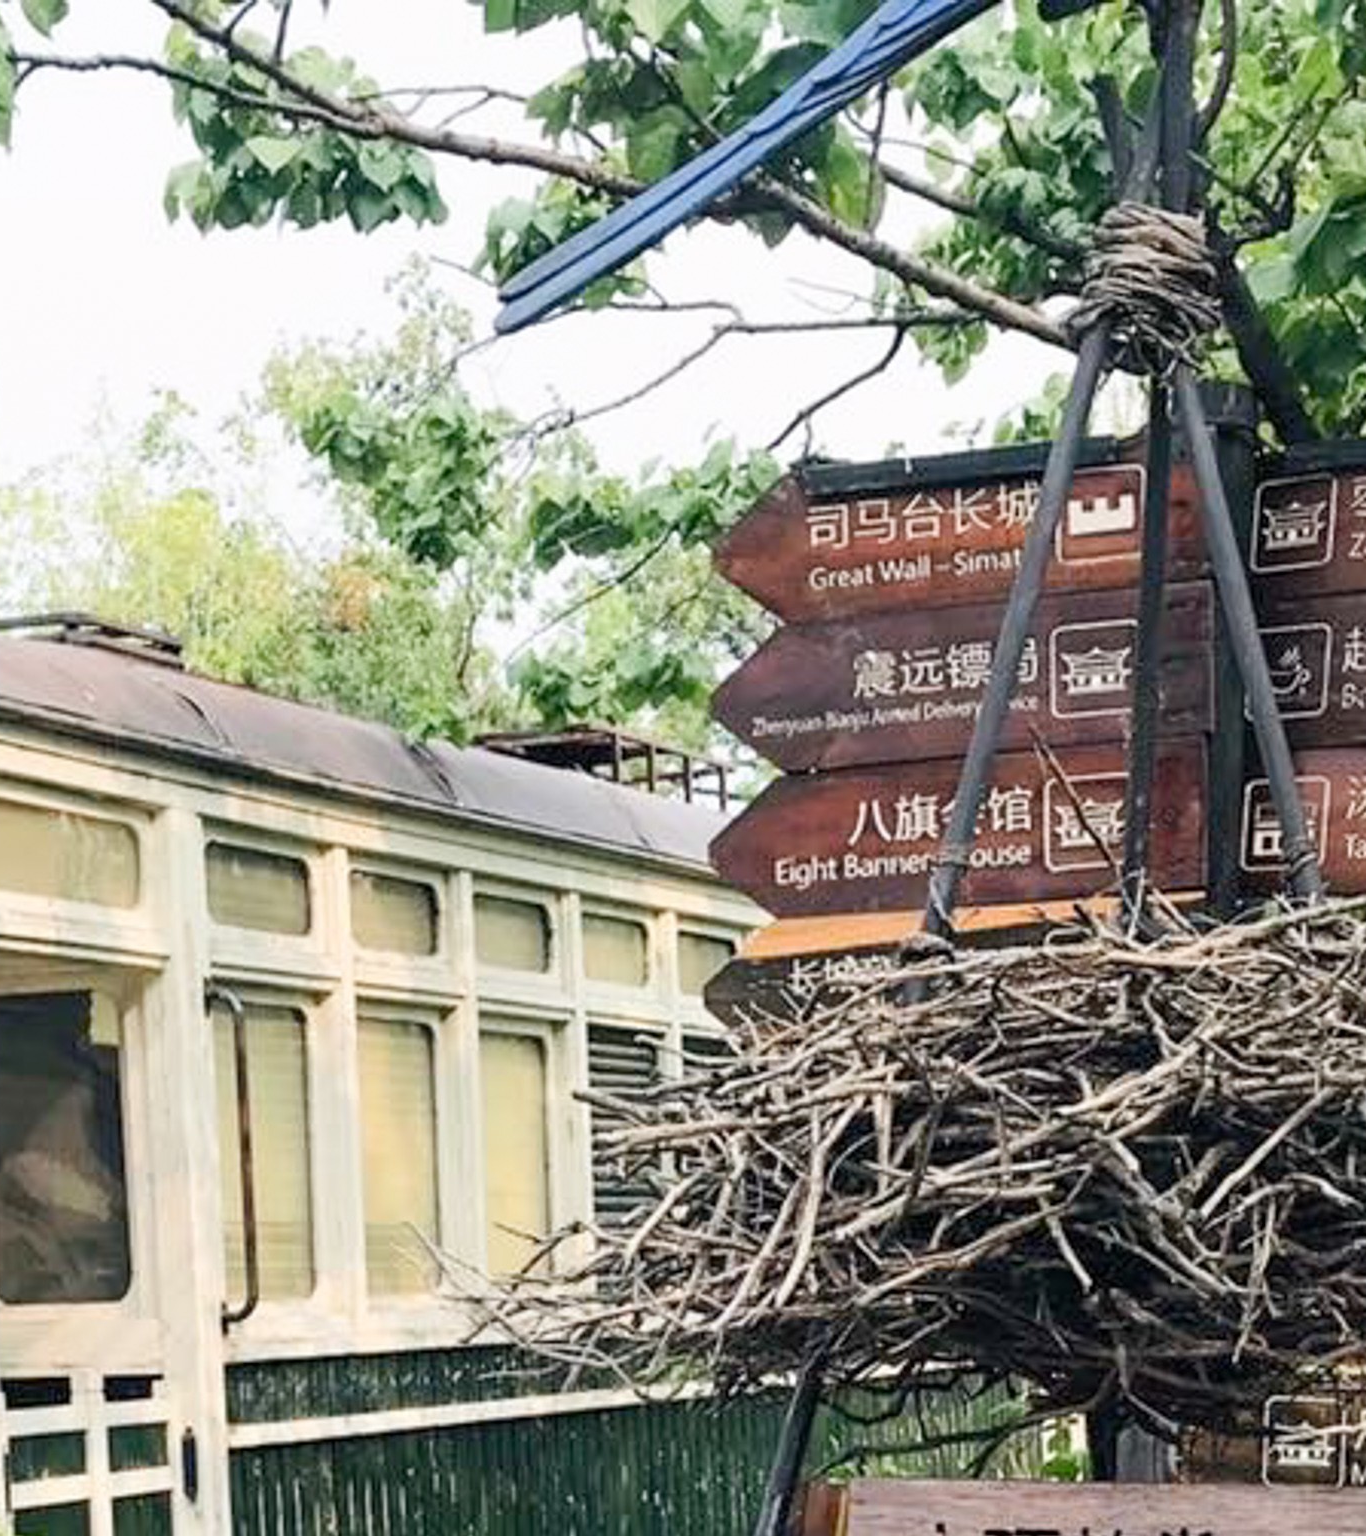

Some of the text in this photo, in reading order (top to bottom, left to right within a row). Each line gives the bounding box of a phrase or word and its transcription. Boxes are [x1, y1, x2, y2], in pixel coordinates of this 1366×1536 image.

[805, 480, 1041, 549] 司马台长城
[808, 563, 874, 590] Great
[877, 554, 931, 583] Wall
[774, 853, 839, 890] Eight
[968, 843, 1032, 869] ouse
